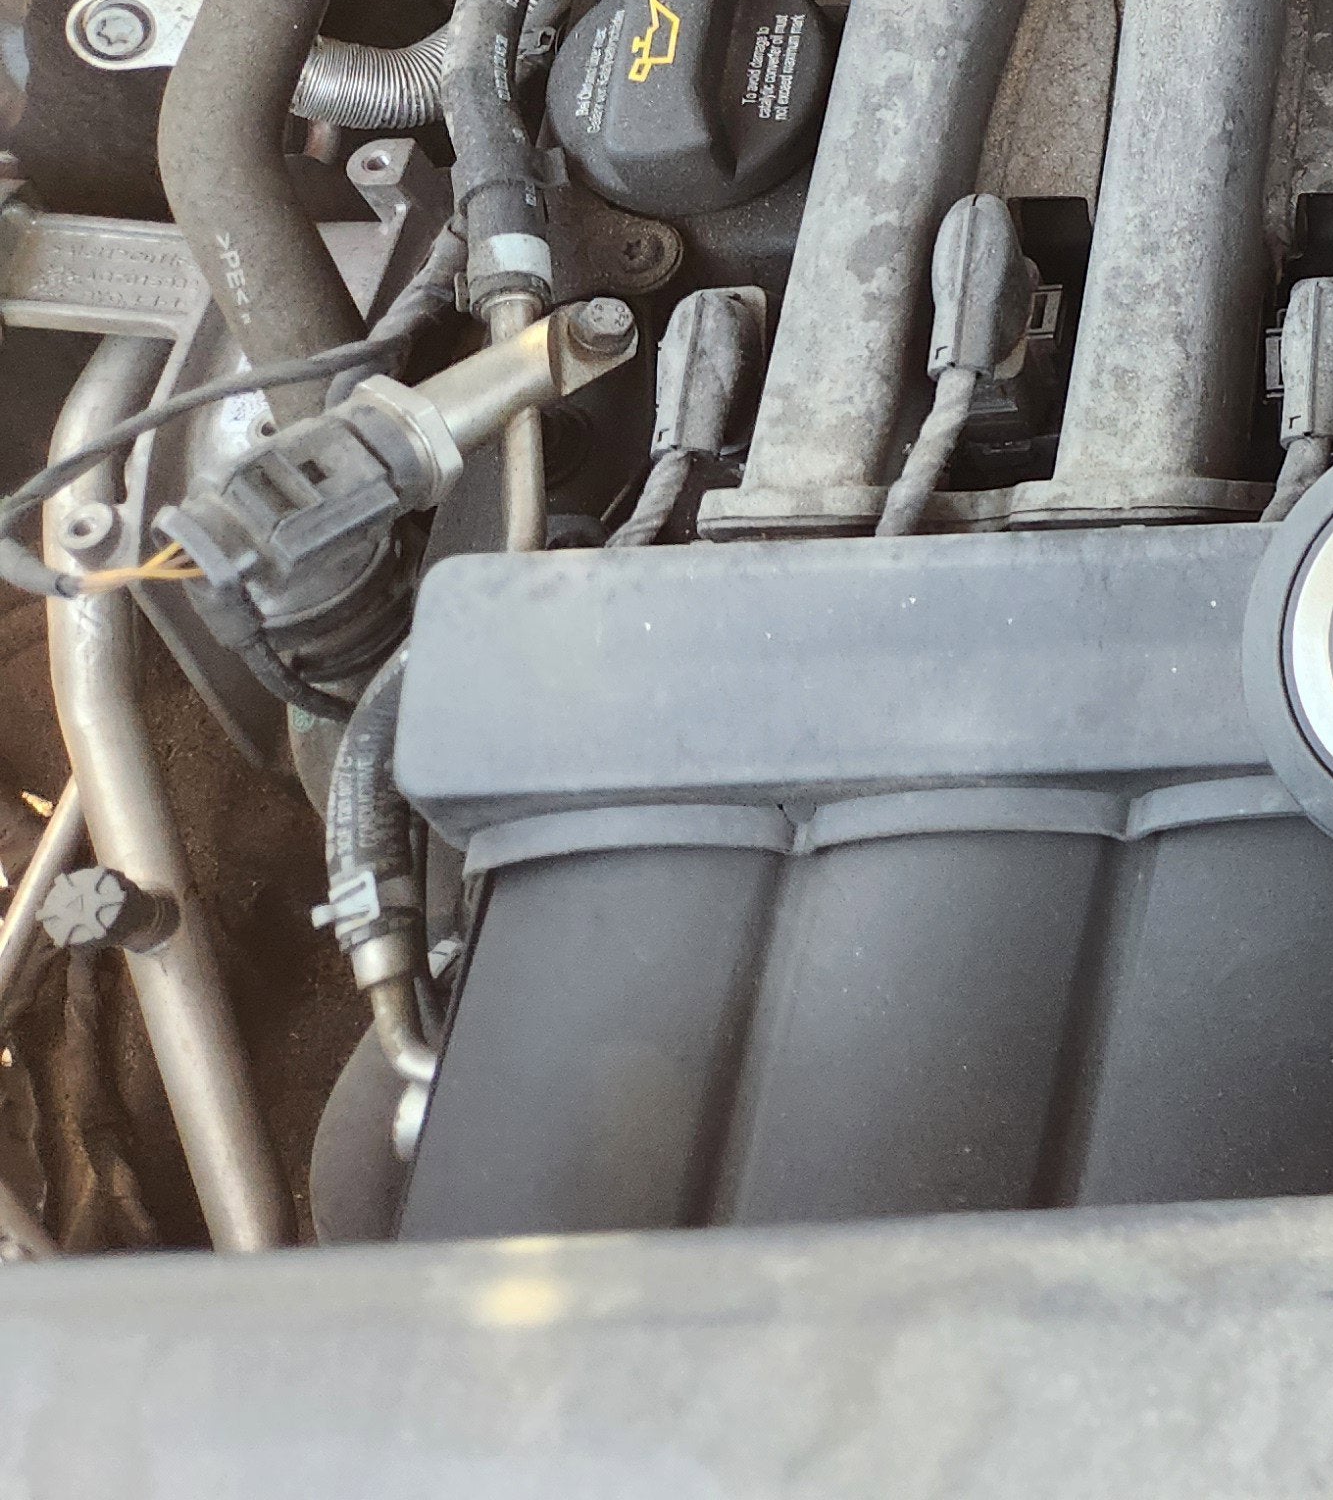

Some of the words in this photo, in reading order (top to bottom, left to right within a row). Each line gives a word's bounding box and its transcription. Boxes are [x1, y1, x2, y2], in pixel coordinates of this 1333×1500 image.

[756, 26, 770, 35] to
[775, 14, 789, 34] must
[769, 34, 784, 45] oil
[749, 36, 770, 68] damage
[782, 35, 801, 74] maximum
[765, 45, 781, 83] converter
[747, 69, 761, 92] avoid
[777, 73, 793, 105] exceed
[742, 92, 757, 105] To
[774, 105, 789, 120] not
